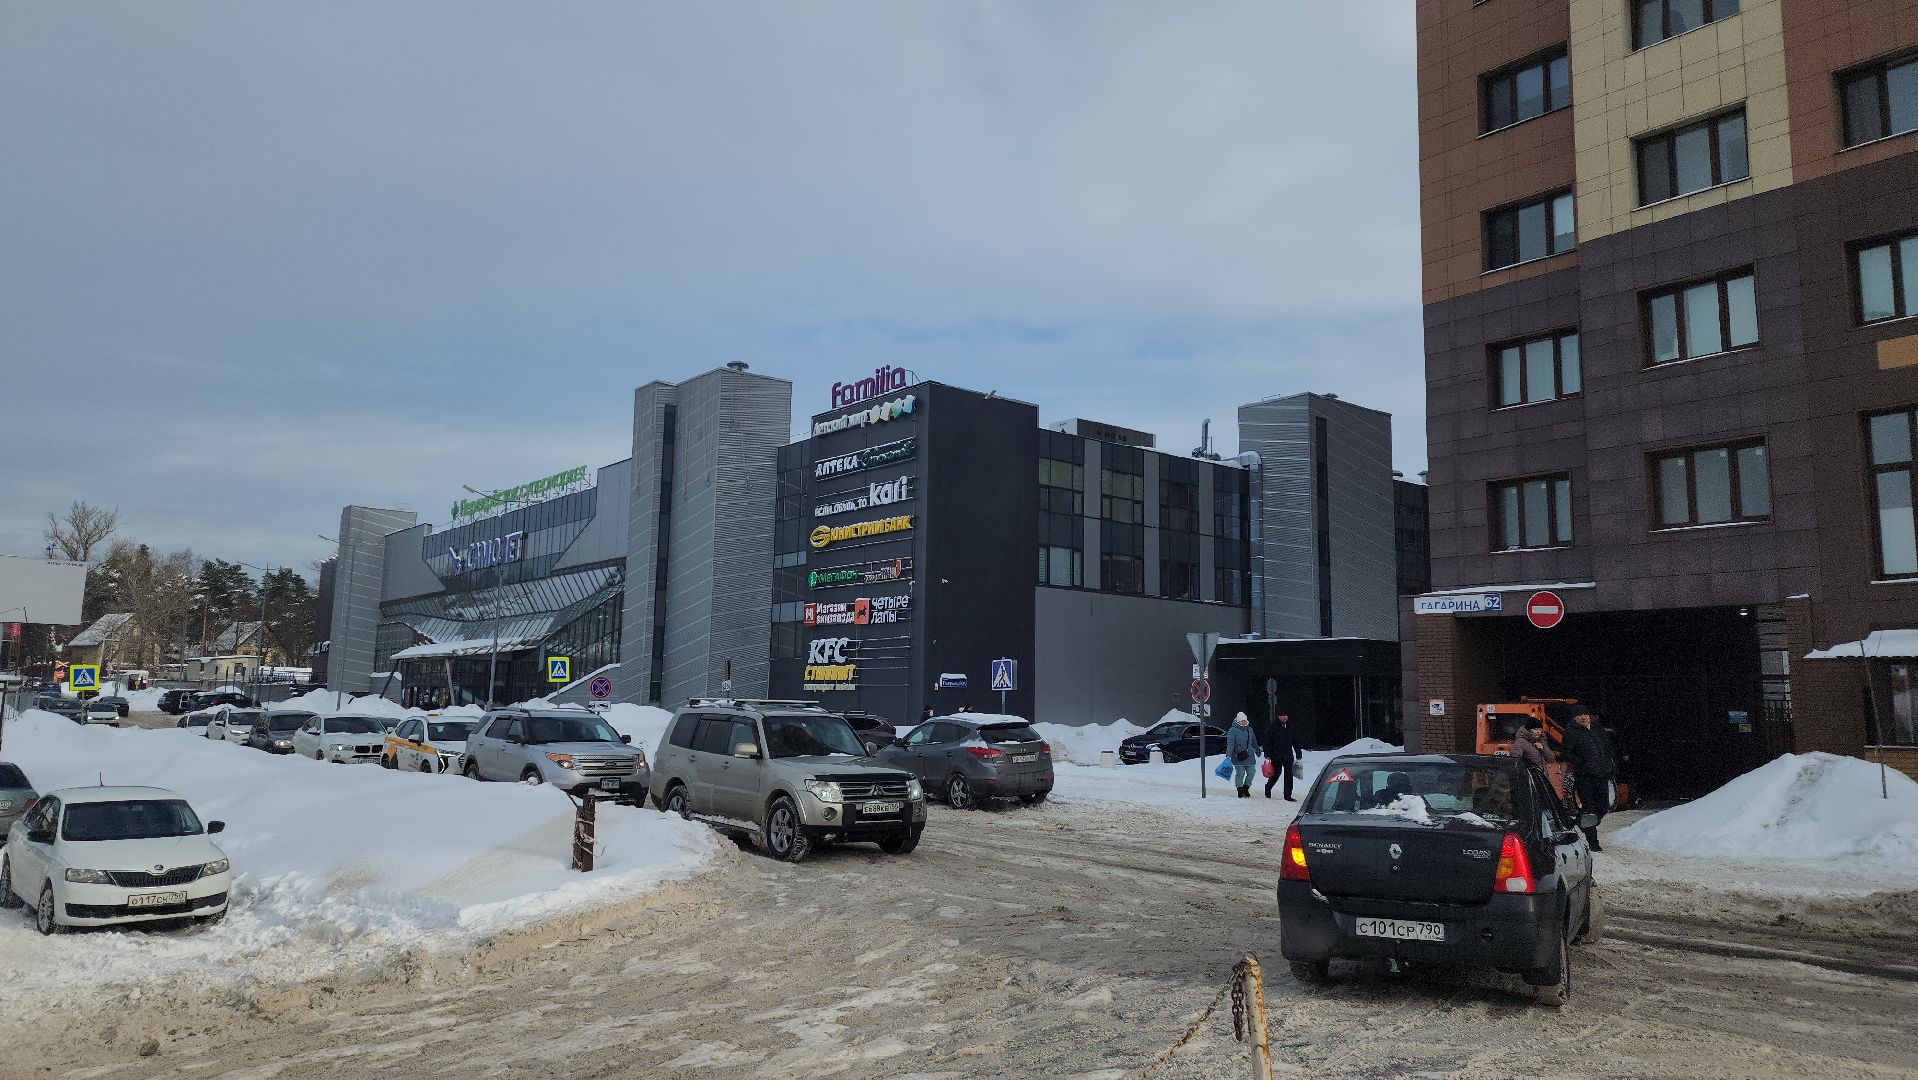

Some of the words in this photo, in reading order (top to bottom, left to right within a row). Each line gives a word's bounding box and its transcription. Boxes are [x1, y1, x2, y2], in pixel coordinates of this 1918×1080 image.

[815, 455, 859, 477] АПТЕКА
[870, 476, 907, 506] kari
[1421, 600, 1480, 611] ГАГАРИНА
[1485, 596, 1500, 608] 62
[808, 637, 850, 663] KFC
[1360, 921, 1415, 938] С101СР
[1418, 923, 1441, 936] 790
